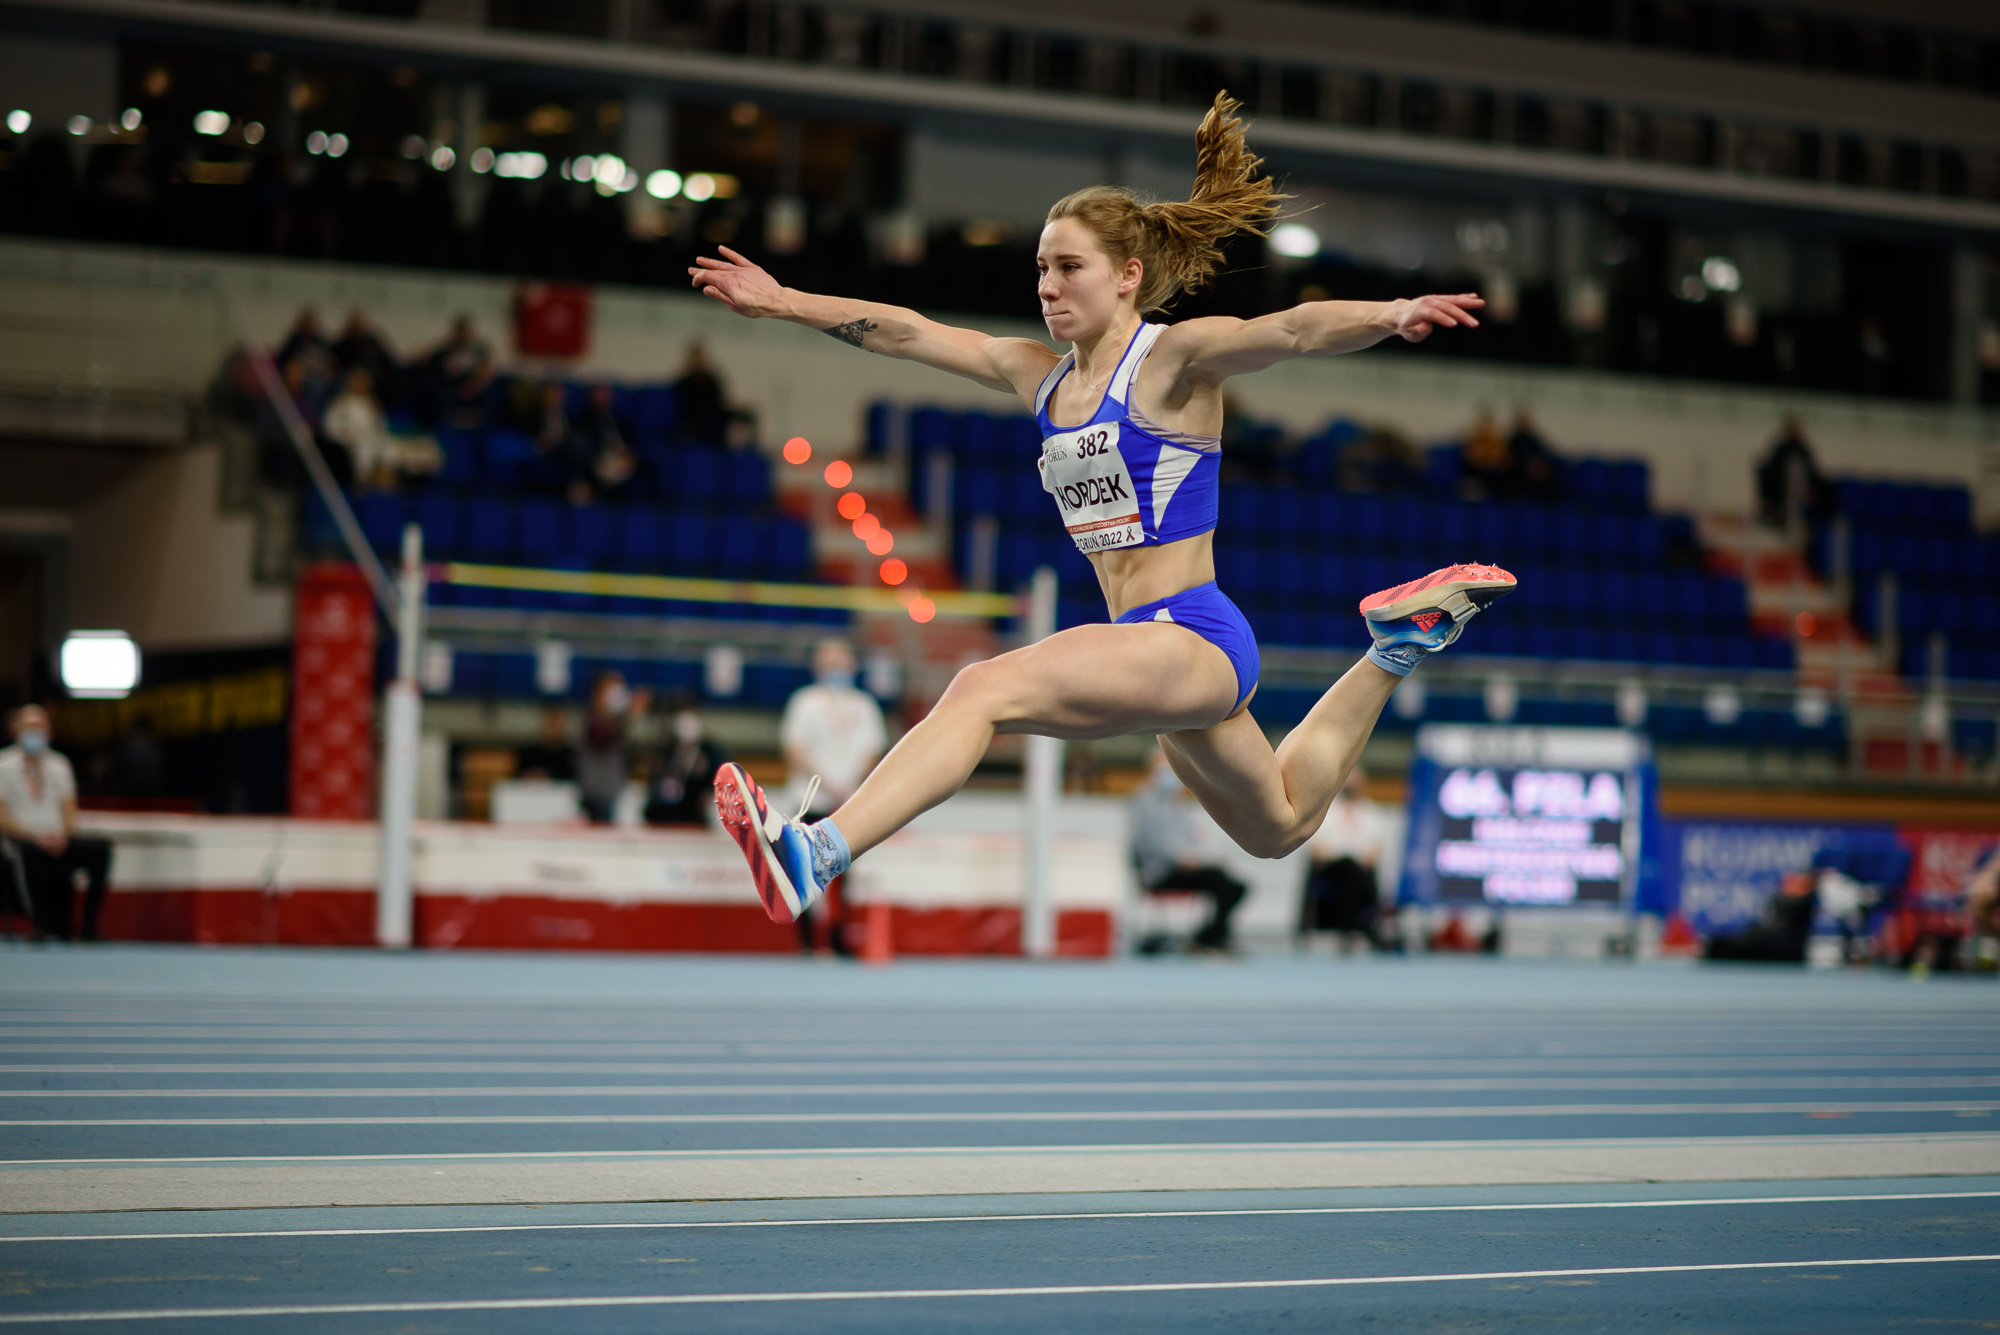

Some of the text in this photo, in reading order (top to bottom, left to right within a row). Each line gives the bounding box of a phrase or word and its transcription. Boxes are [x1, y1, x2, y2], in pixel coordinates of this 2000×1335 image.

[1076, 430, 1109, 460] 382
[1099, 530, 1123, 547] 2022
[1411, 611, 1442, 622] adidas
